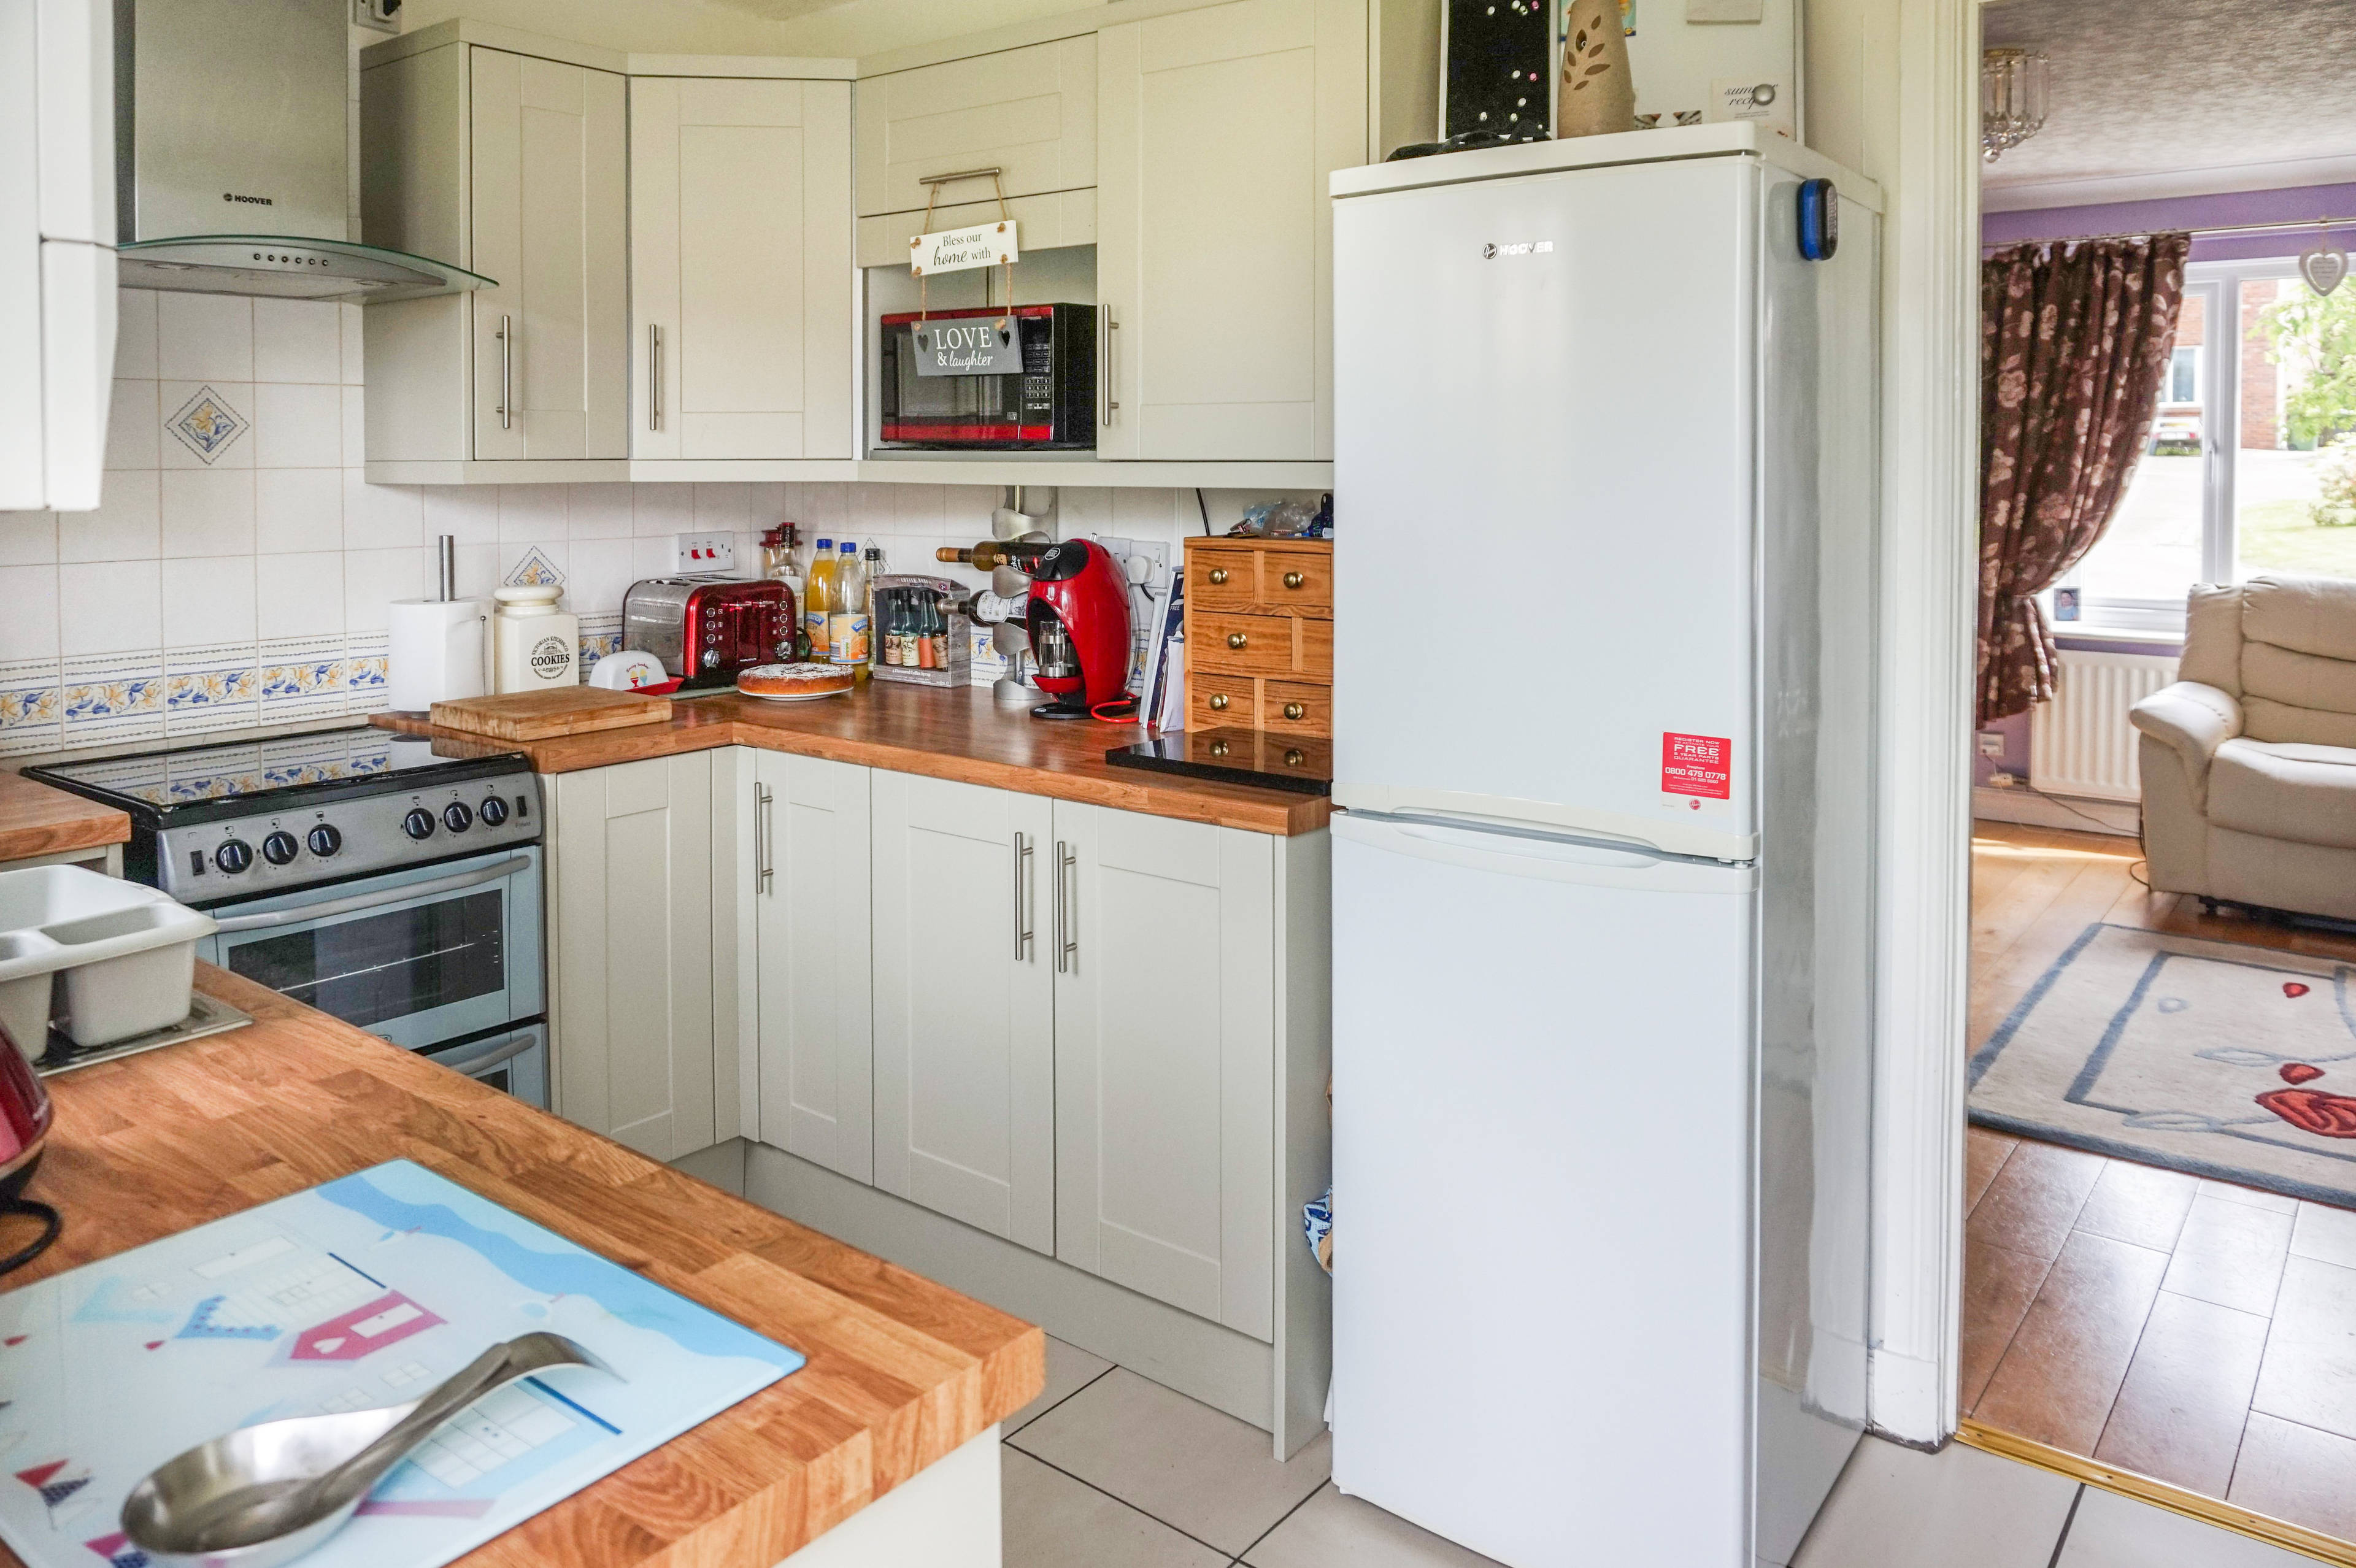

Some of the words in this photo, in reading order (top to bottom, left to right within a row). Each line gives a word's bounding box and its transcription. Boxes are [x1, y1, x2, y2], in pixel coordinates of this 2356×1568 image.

[1725, 84, 1779, 96] sumr
[234, 195, 272, 206] HOOVER
[942, 235, 964, 247] Bless
[966, 233, 982, 243] our
[1499, 240, 1553, 256] HOOVER
[933, 246, 968, 266] home
[971, 247, 991, 260] with
[934, 326, 992, 350] LOVE
[937, 352, 947, 366] &
[949, 350, 993, 371] laughter
[531, 653, 570, 667] COOKIES
[1674, 744, 1719, 756] FREE
[1674, 756, 1719, 764] GUARANTEE
[1665, 767, 1686, 775] 0800
[1705, 772, 1727, 780] 0778
